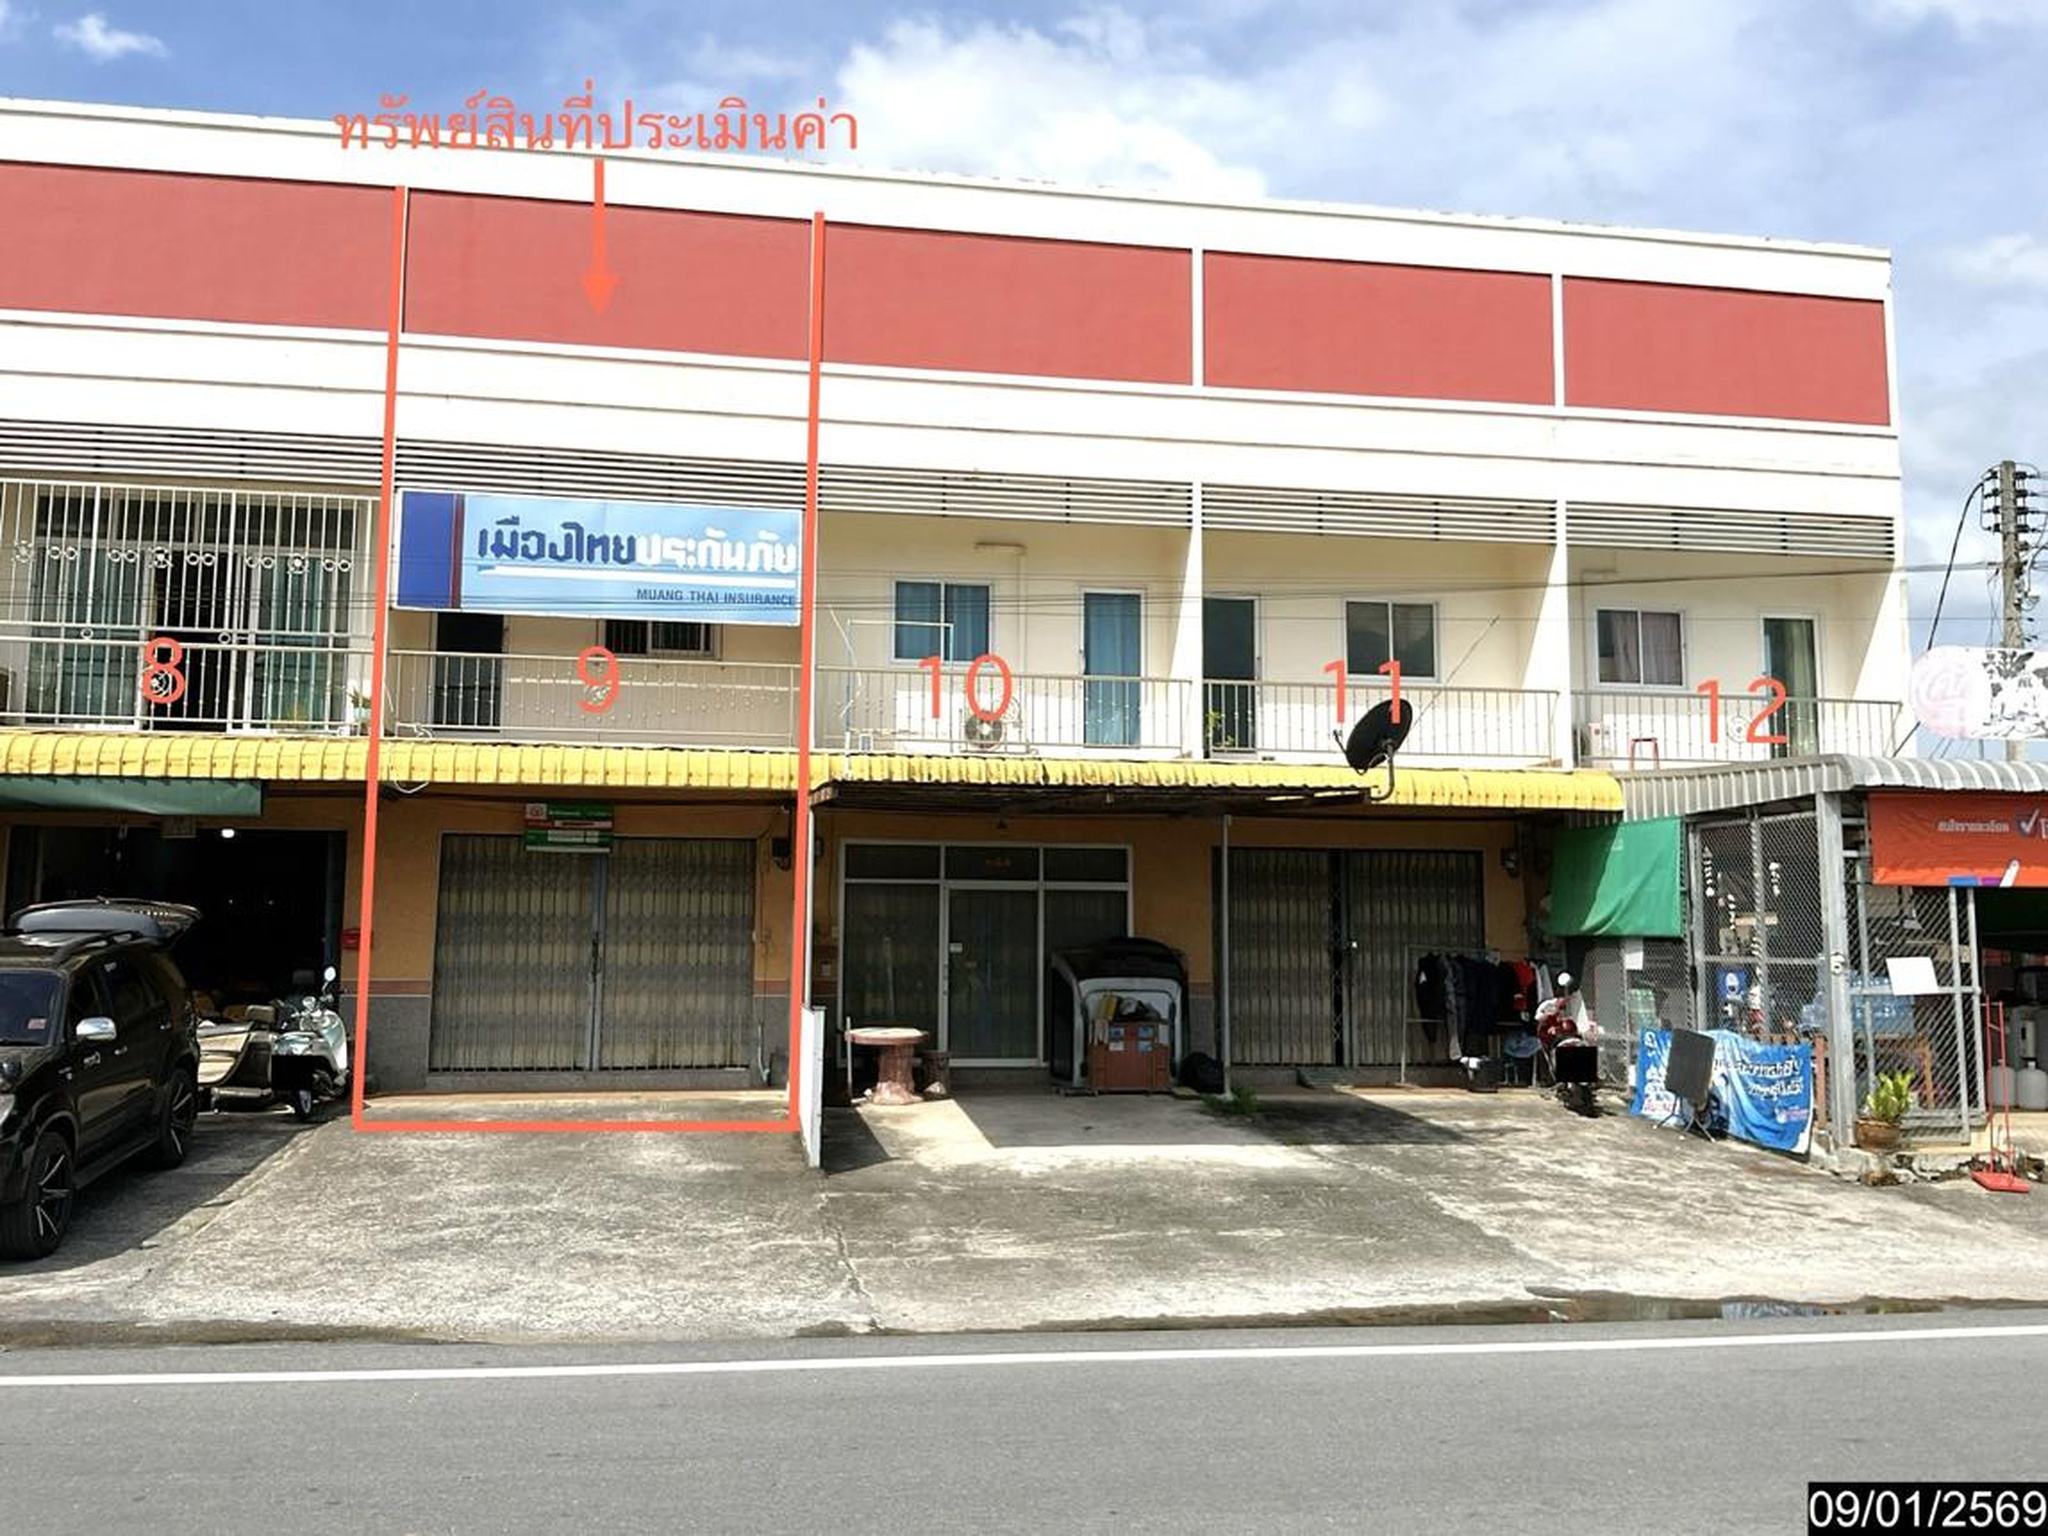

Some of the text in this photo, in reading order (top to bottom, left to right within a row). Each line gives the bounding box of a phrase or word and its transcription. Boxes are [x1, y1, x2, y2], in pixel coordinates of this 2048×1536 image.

[637, 588, 796, 606] MUANG THAI INSURANCE
